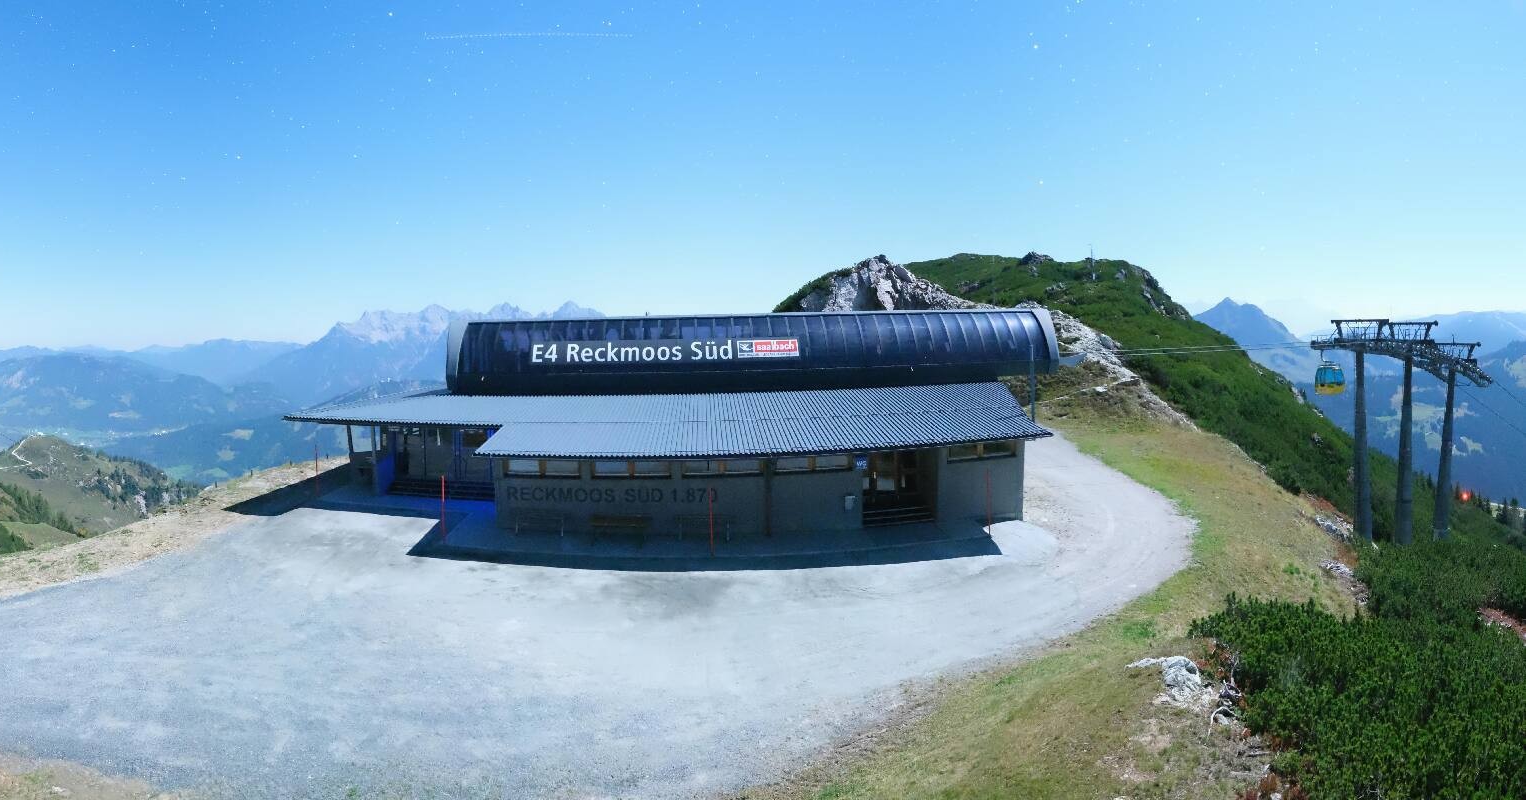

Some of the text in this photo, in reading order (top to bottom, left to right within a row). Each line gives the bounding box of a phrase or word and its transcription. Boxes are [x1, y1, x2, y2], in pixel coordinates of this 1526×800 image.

[532, 340, 732, 362] E4 Reckmoos Süd
[756, 340, 795, 351] saalbach
[506, 486, 616, 502] RECKMOOS
[671, 487, 718, 503] 1.870
